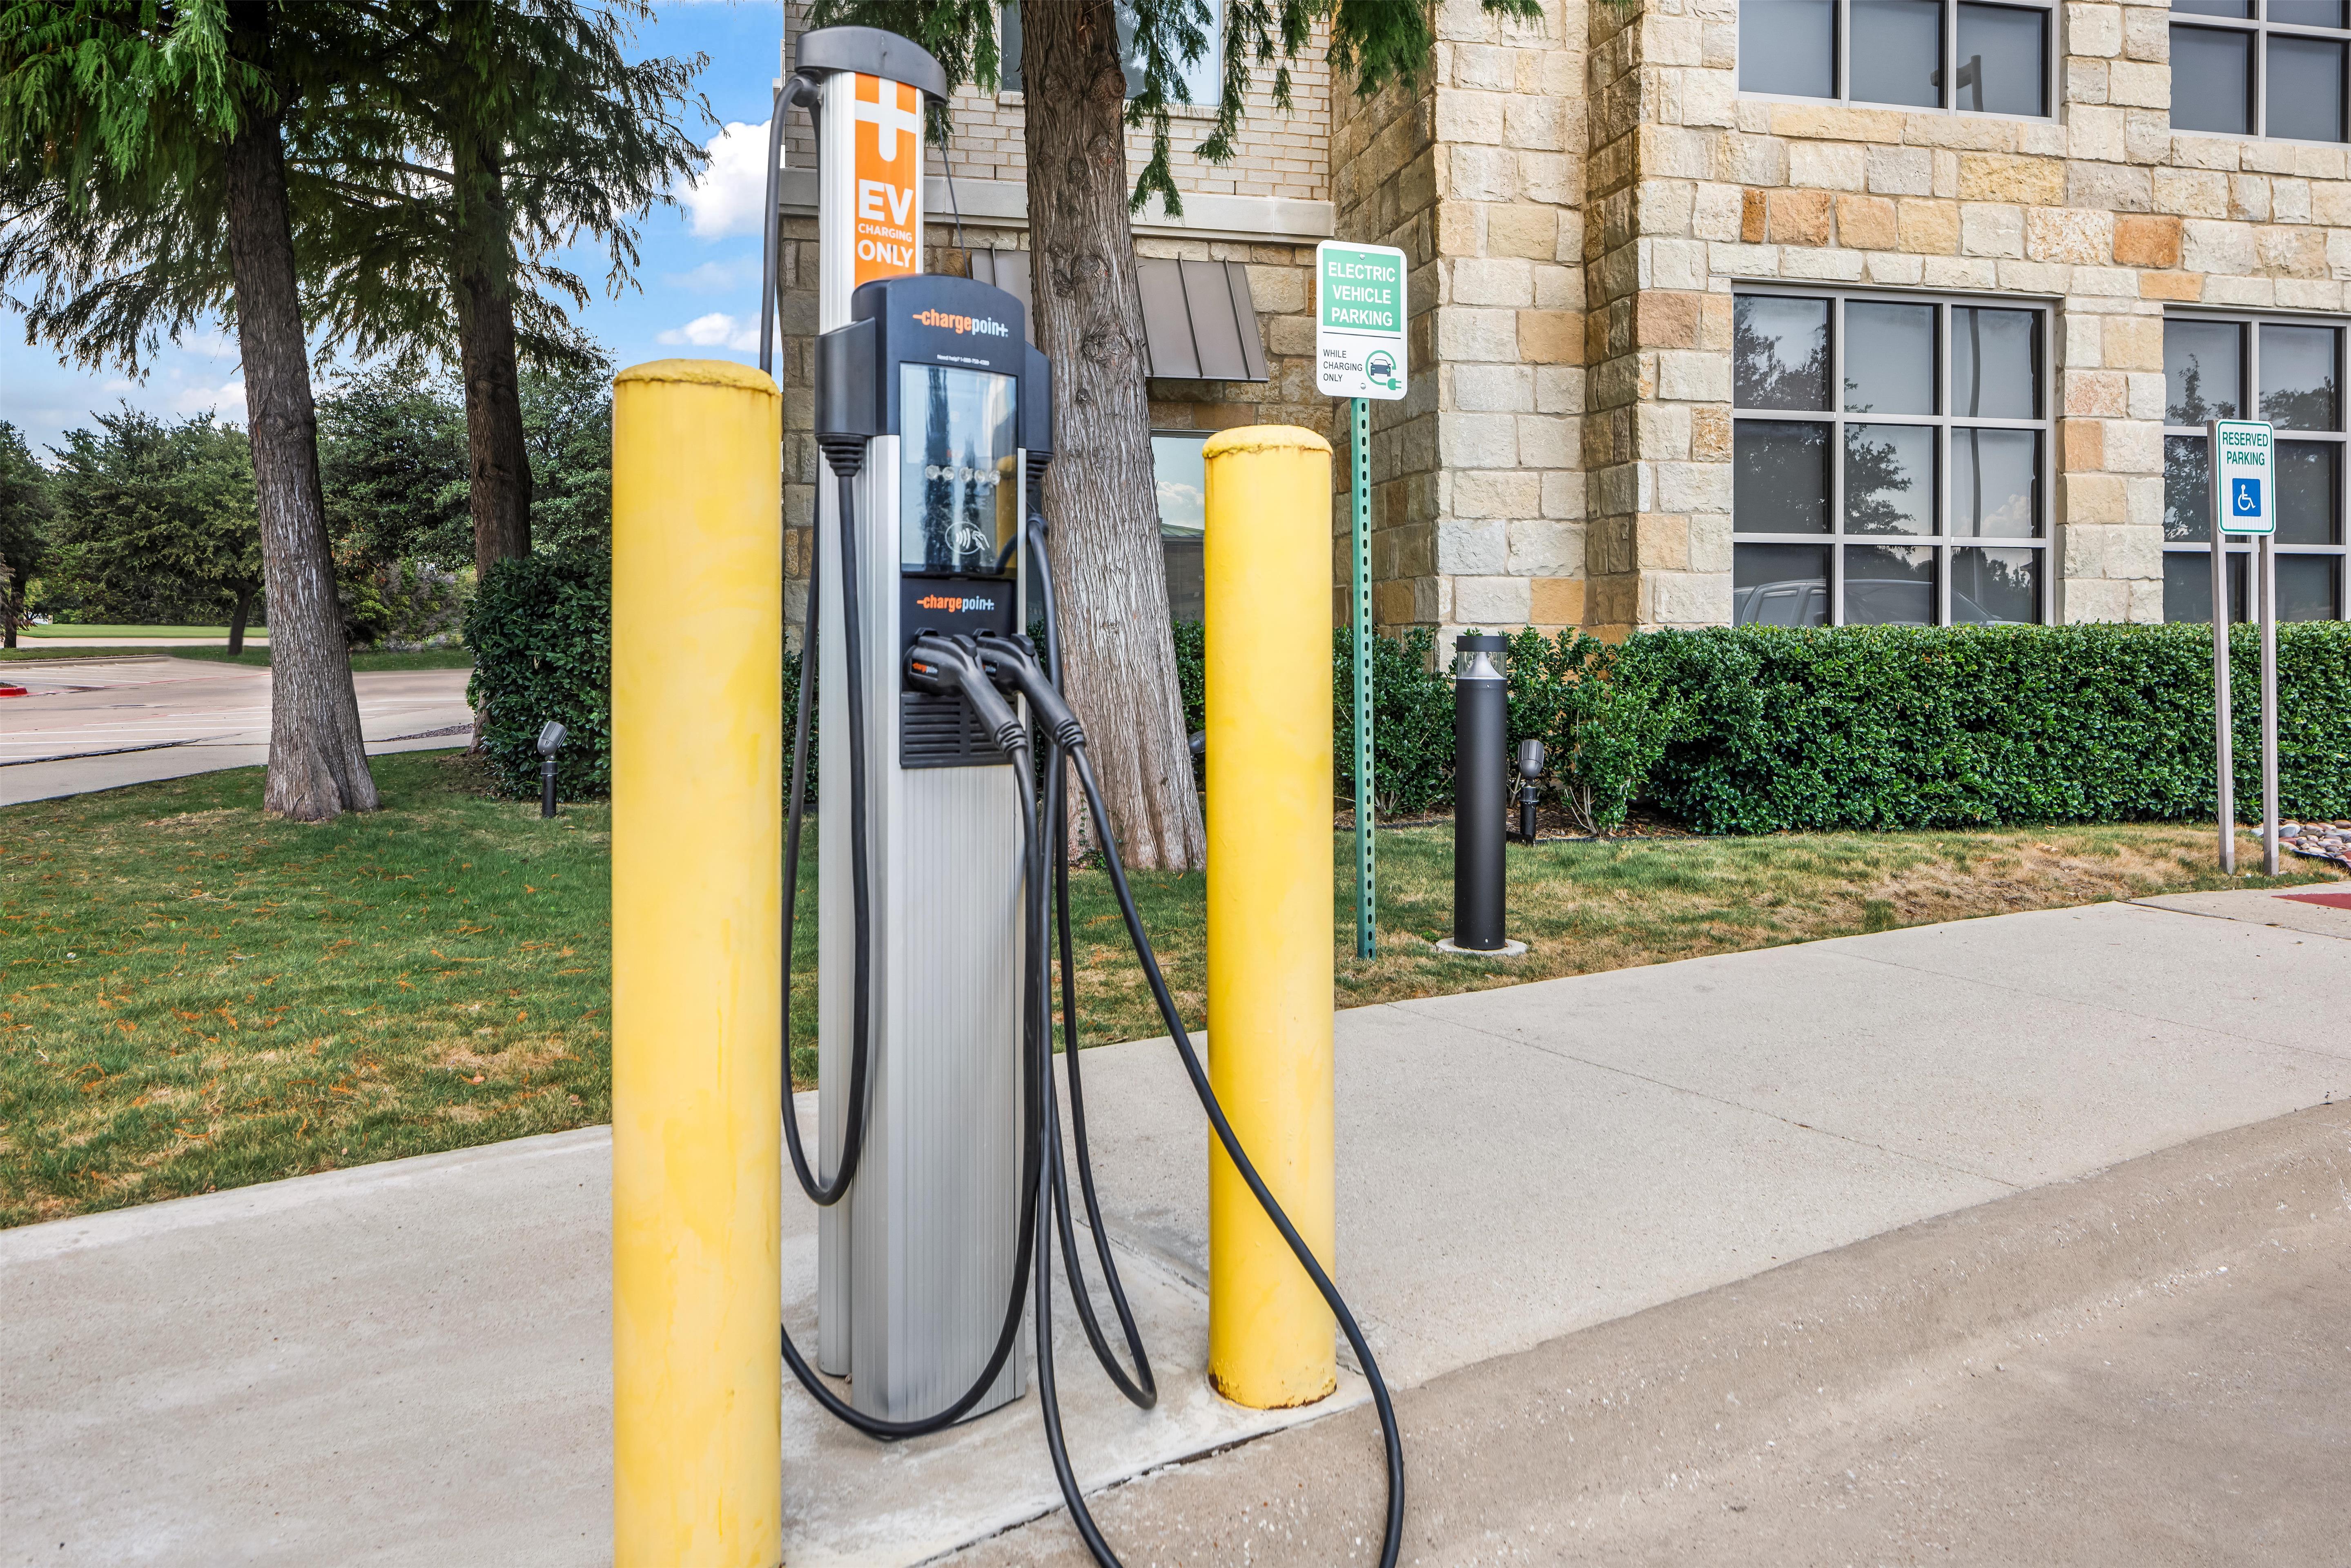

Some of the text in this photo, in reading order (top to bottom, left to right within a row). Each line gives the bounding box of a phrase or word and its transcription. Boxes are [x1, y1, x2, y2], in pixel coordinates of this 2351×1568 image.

[859, 178, 914, 225] EV
[858, 223, 913, 242] CHARGING
[858, 239, 914, 268] ONLY
[1328, 261, 1396, 283] ELECTRIC
[1332, 284, 1391, 304] VEHICLE
[1332, 307, 1393, 327] PARKING
[1323, 349, 1347, 358] WHILE
[1323, 361, 1363, 371] CHARGING
[1323, 373, 1343, 382] ONLY
[2222, 432, 2269, 447] RESERVED
[2227, 451, 2265, 466] PARKING
